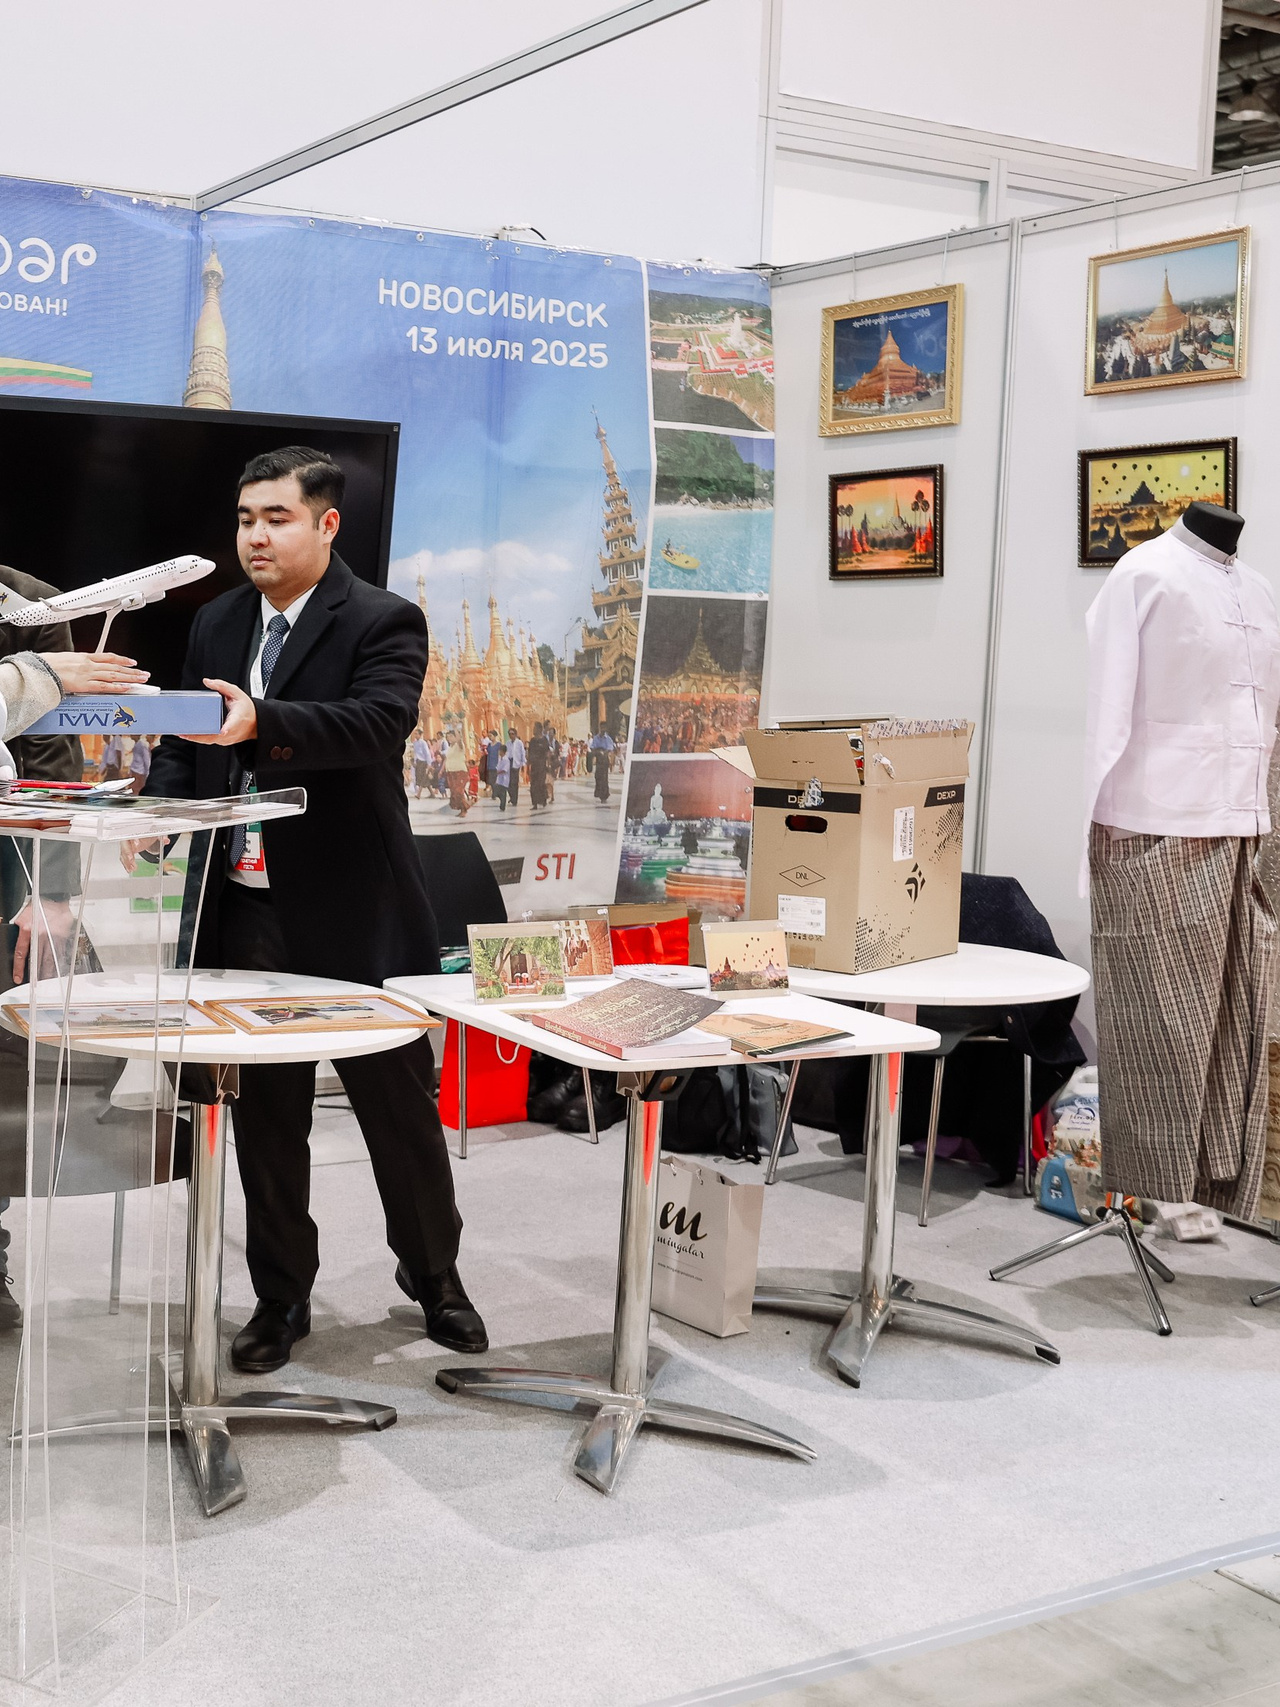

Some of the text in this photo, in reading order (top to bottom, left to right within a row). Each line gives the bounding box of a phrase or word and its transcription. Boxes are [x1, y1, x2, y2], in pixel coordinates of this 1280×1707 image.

[377, 277, 609, 329] НОВОСИБИРСК
[405, 325, 609, 369] 13 июля 2025
[58, 713, 110, 727] MAI
[937, 790, 956, 800] DEXP
[535, 853, 576, 881] STI
[657, 1235, 705, 1259] mingalar
